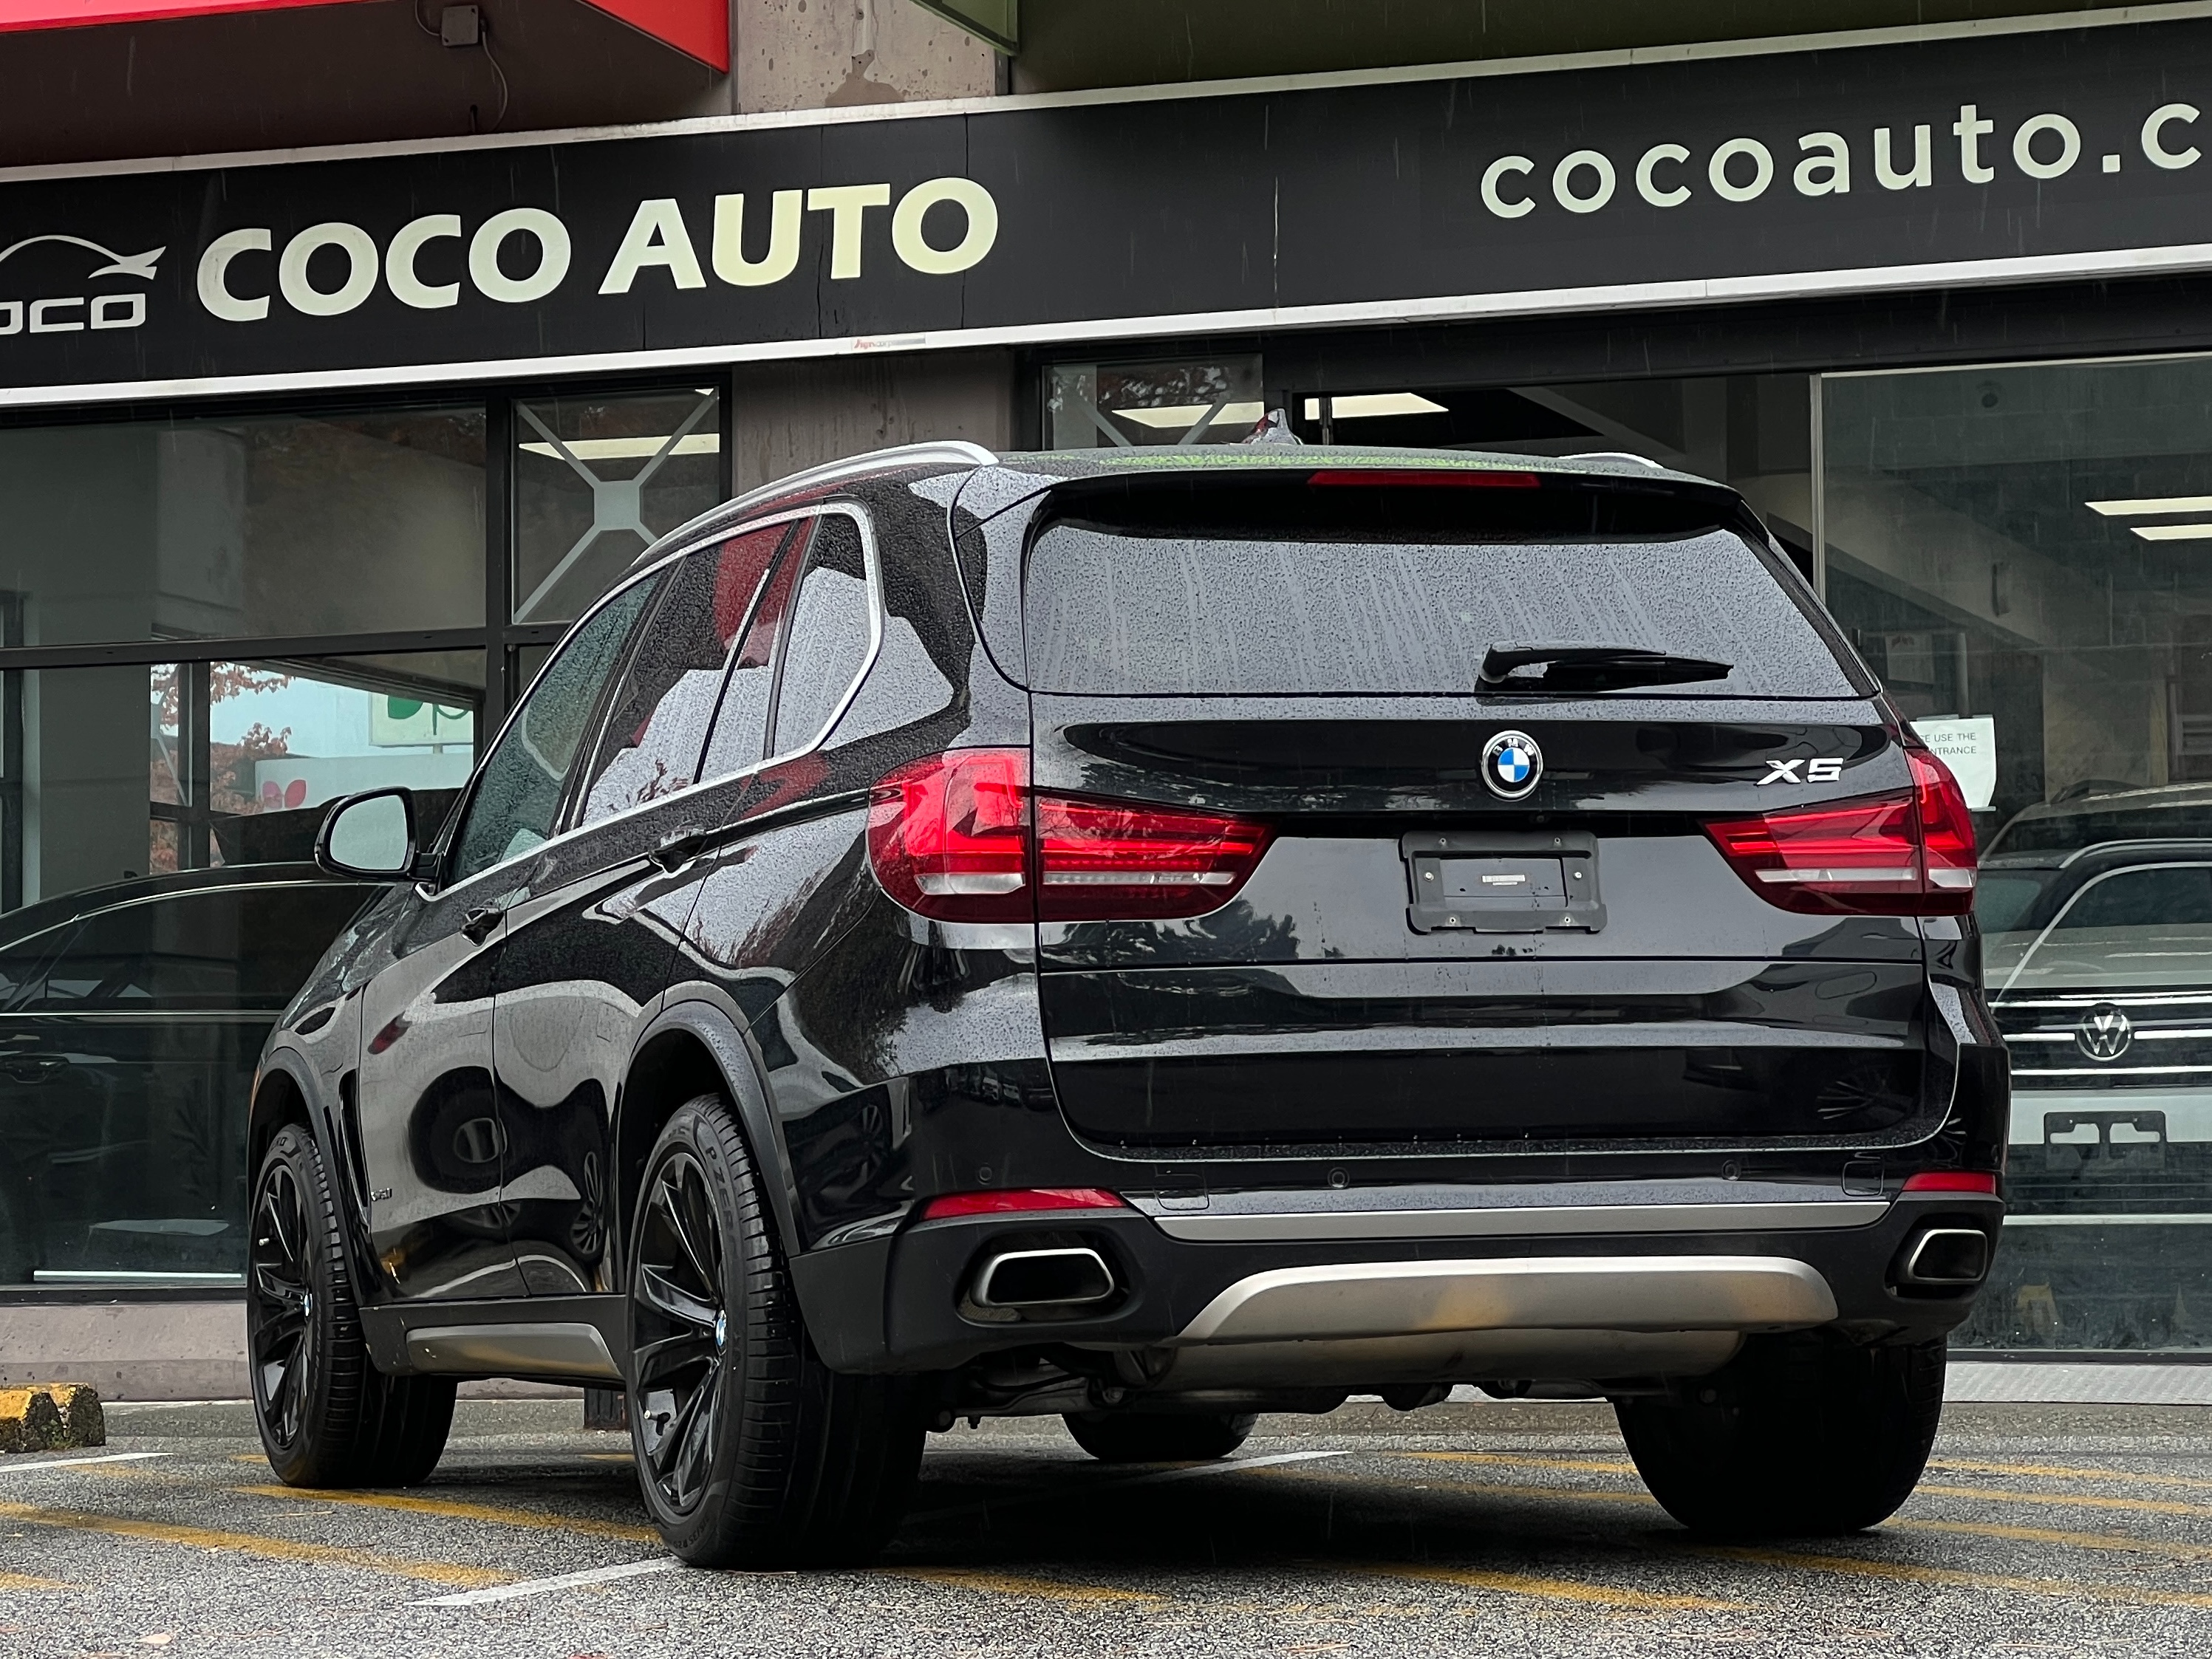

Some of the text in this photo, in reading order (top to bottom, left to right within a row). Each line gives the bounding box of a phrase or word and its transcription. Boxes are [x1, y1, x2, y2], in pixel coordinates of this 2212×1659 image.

[197, 176, 999, 323] COCO AUTO
[1934, 733, 1953, 742] USE
[1957, 732, 1976, 741] THE
[1756, 757, 1844, 785] X5
